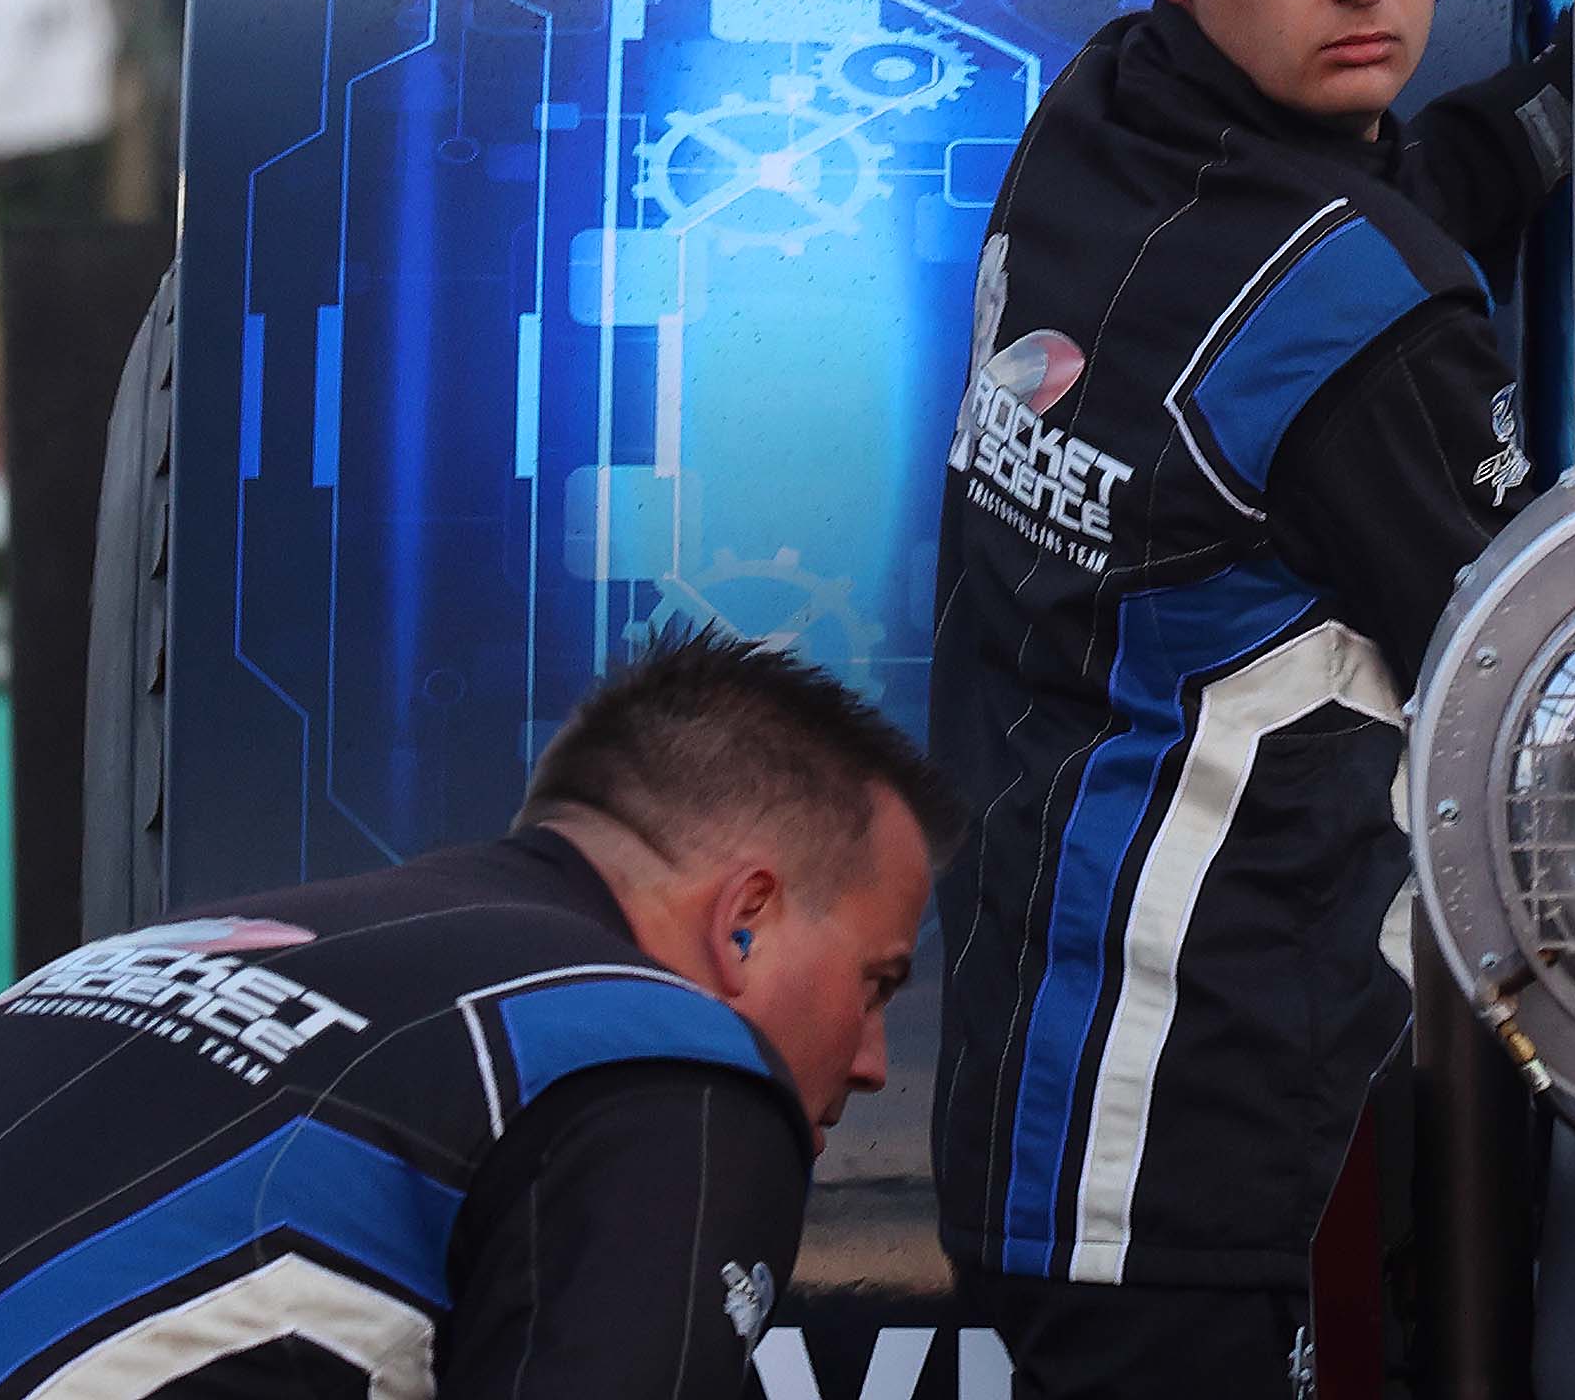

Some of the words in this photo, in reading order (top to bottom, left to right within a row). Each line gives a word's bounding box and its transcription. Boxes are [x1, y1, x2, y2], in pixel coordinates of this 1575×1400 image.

[972, 369, 1136, 504] ROCKET
[974, 432, 1113, 544] SCIENCE
[25, 969, 301, 1065] SCIENCE
